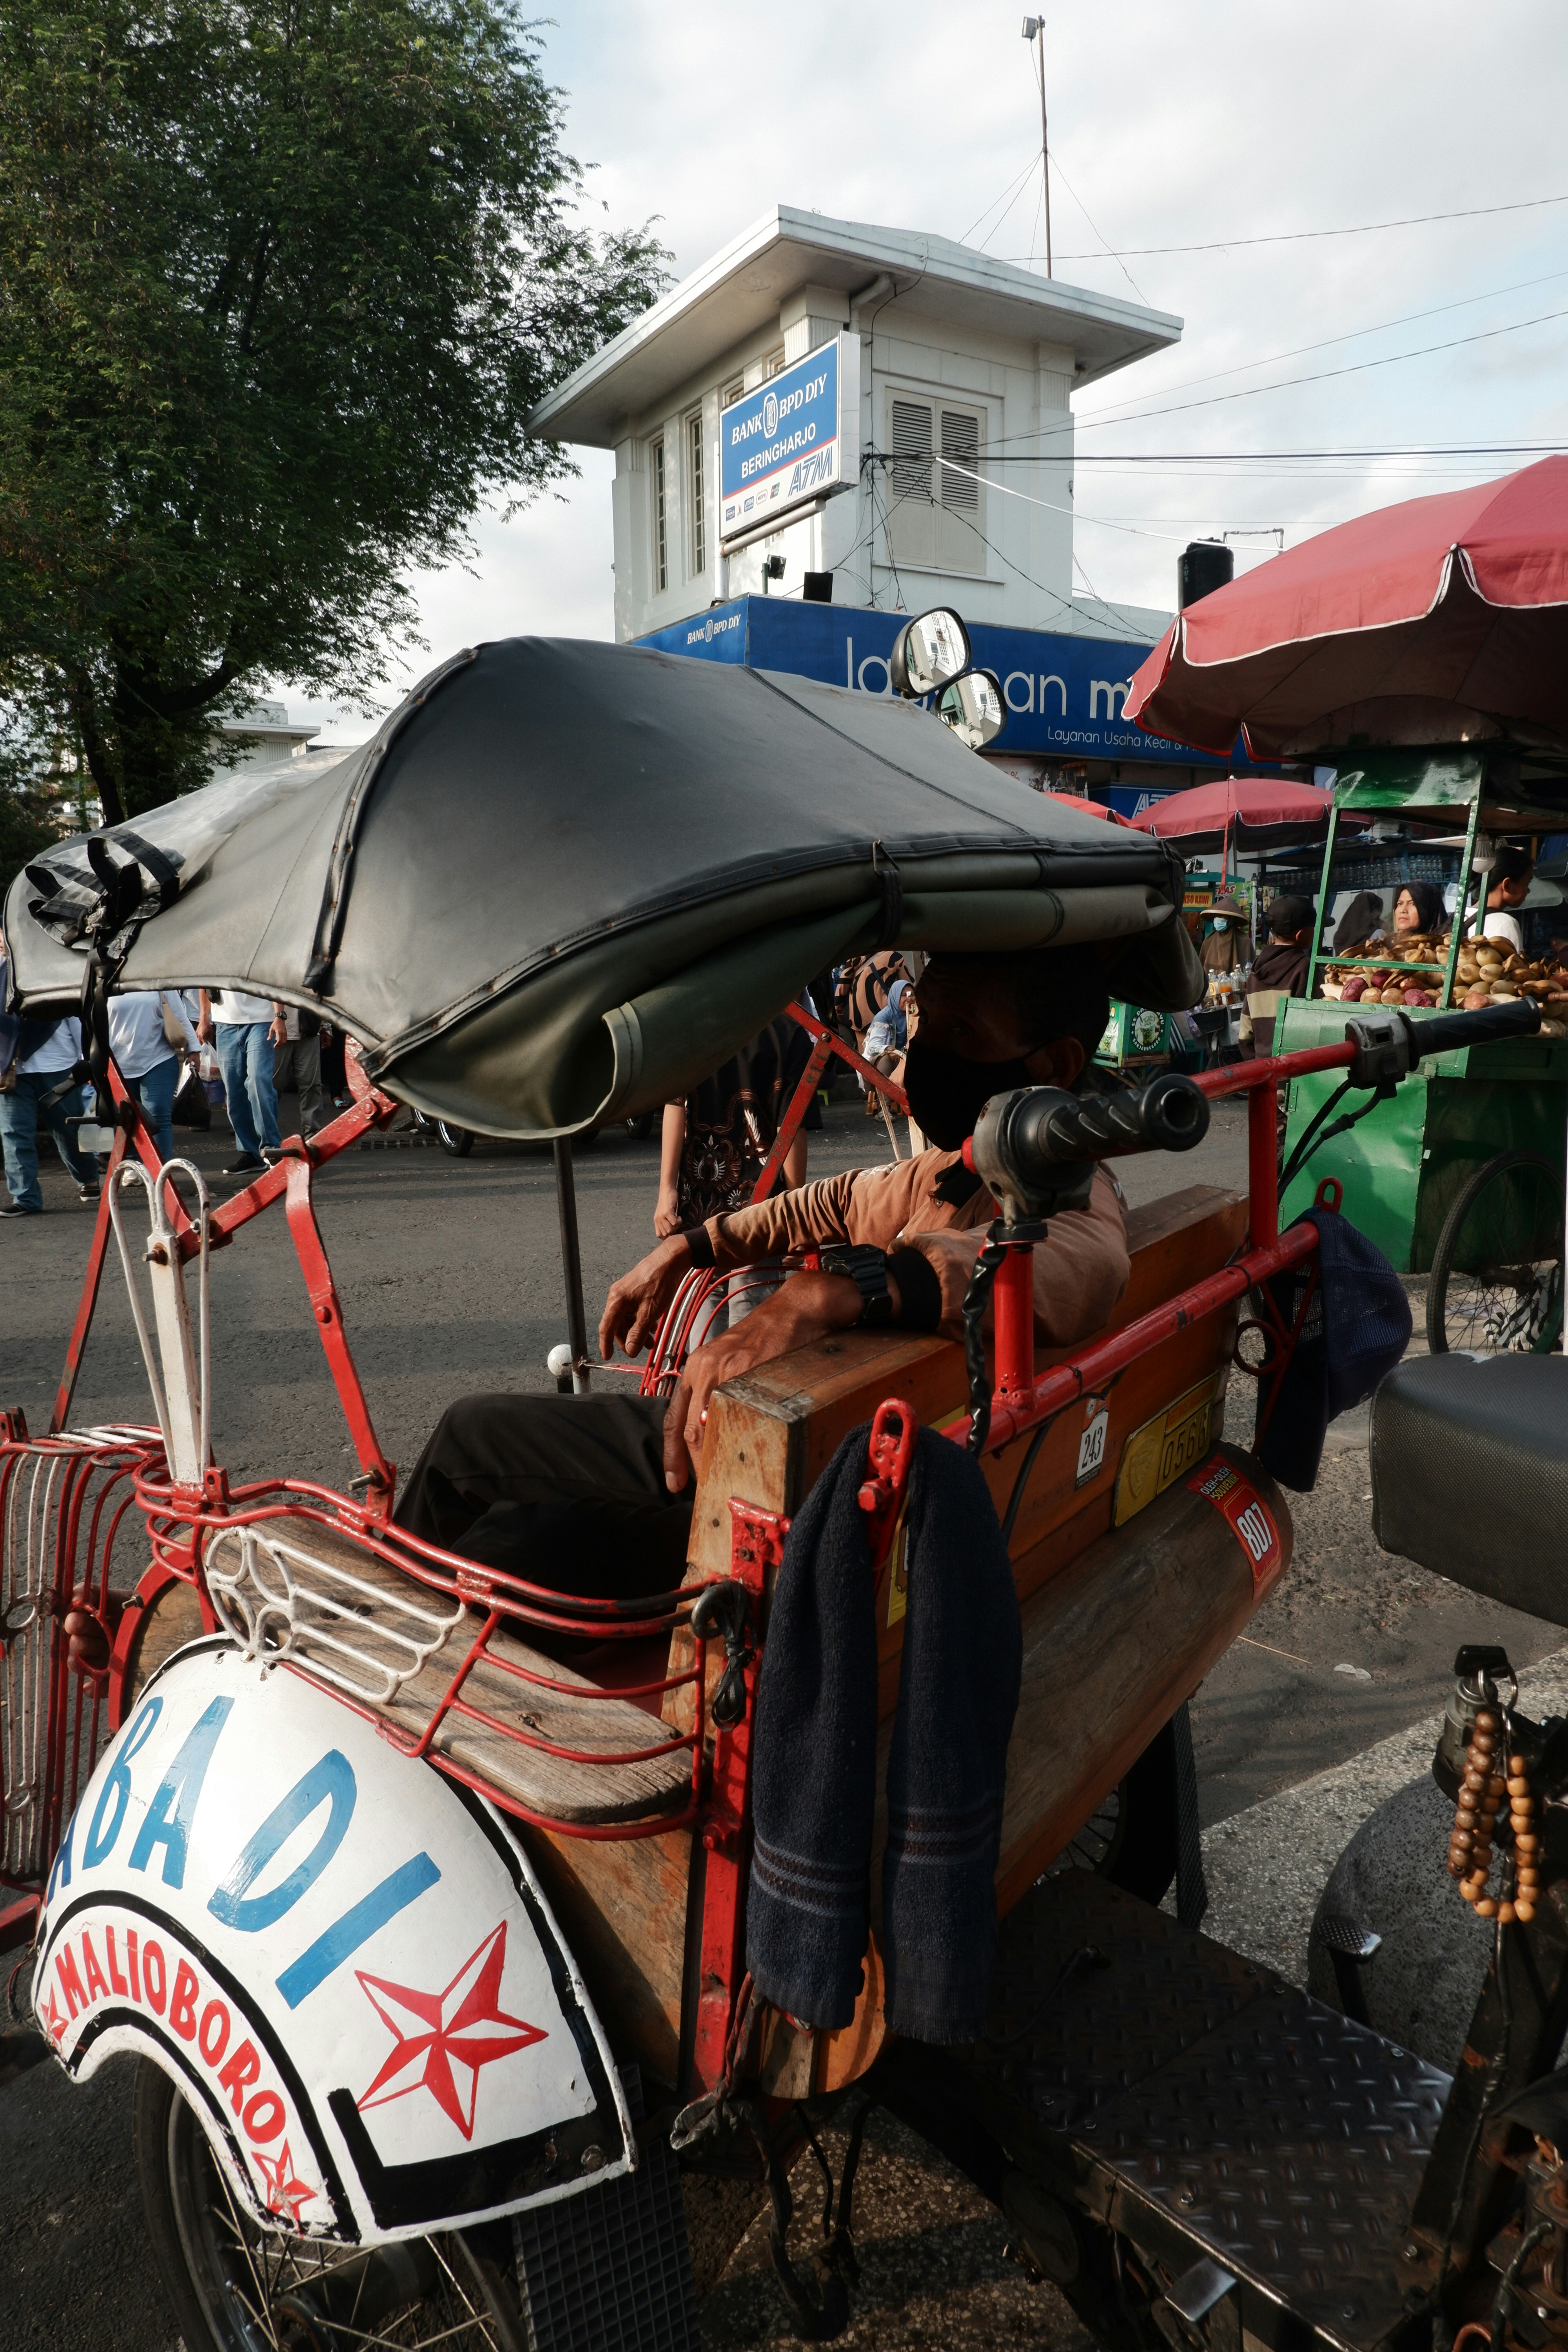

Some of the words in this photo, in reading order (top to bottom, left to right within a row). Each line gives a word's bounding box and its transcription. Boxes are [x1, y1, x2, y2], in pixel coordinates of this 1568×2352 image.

[731, 412, 762, 446] BANK
[779, 389, 803, 419] BPD
[805, 373, 827, 403] DIY
[741, 423, 816, 479] BERINGHARJO
[788, 445, 833, 497] ATM
[757, 492, 766, 501] MEPS
[687, 627, 704, 644] BANK
[713, 619, 727, 635] BPD
[728, 614, 741, 628] DIY
[847, 637, 1067, 716] laan
[1048, 726, 1100, 744] Layanan
[1105, 731, 1141, 747] Usaha
[1195, 895, 1209, 904] KAWI
[1131, 1017, 1137, 1026] ES
[1082, 1426, 1103, 1469] 243
[1163, 1413, 1207, 1479] 0566
[1200, 1465, 1232, 1495] OLEH-OLEH
[1212, 1473, 1240, 1501] SOUVENIR
[1236, 1501, 1273, 1562] 807
[45, 1695, 442, 2009] ABADI
[55, 1924, 286, 2143] MALIOBORO
